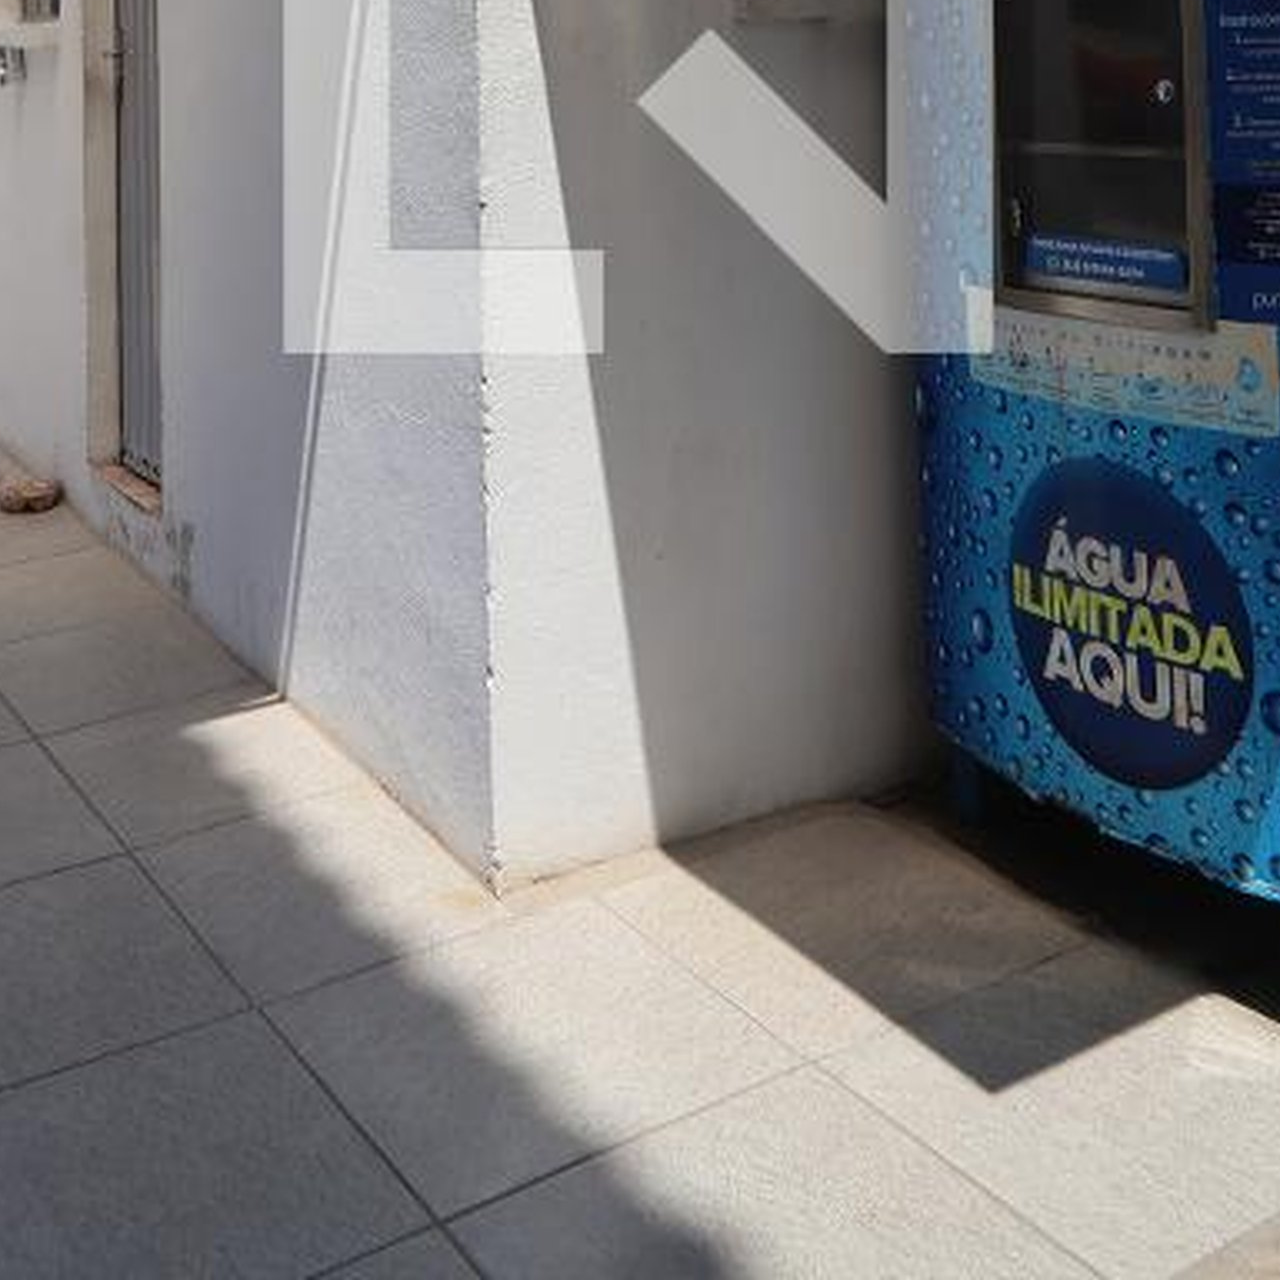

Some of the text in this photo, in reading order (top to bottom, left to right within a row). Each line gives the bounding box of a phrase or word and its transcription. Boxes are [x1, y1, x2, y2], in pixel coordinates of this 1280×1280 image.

[1045, 517, 1192, 614] ÁGUA
[1012, 562, 1245, 682] ILIMITADA
[1042, 626, 1207, 735] AQUI!
